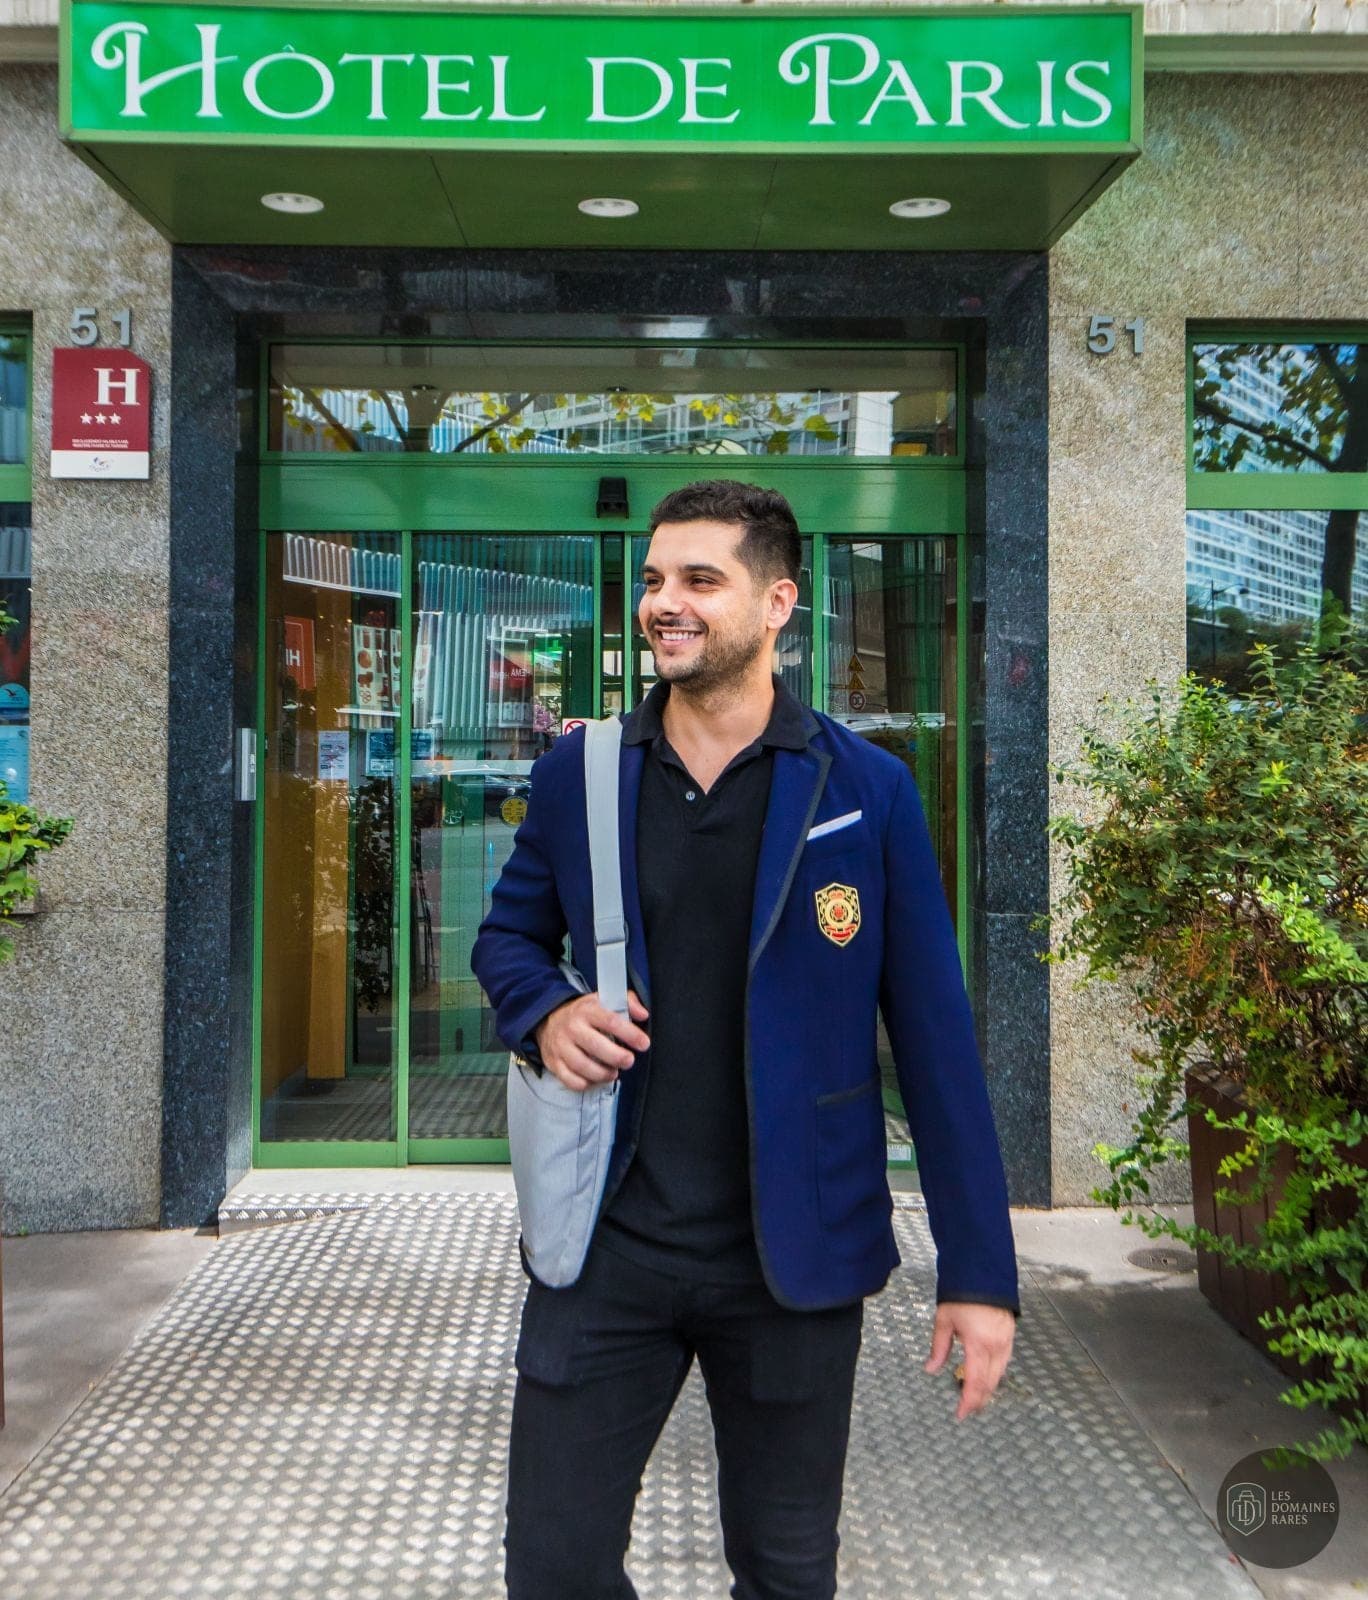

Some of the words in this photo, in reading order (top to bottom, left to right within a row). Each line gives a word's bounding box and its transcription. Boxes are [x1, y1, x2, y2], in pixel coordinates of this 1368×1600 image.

[90, 20, 547, 122] HÔTEL
[585, 56, 741, 124] DE
[777, 32, 1113, 130] PARIS
[69, 307, 132, 347] 51
[1087, 314, 1147, 354] 51
[93, 367, 141, 406] H
